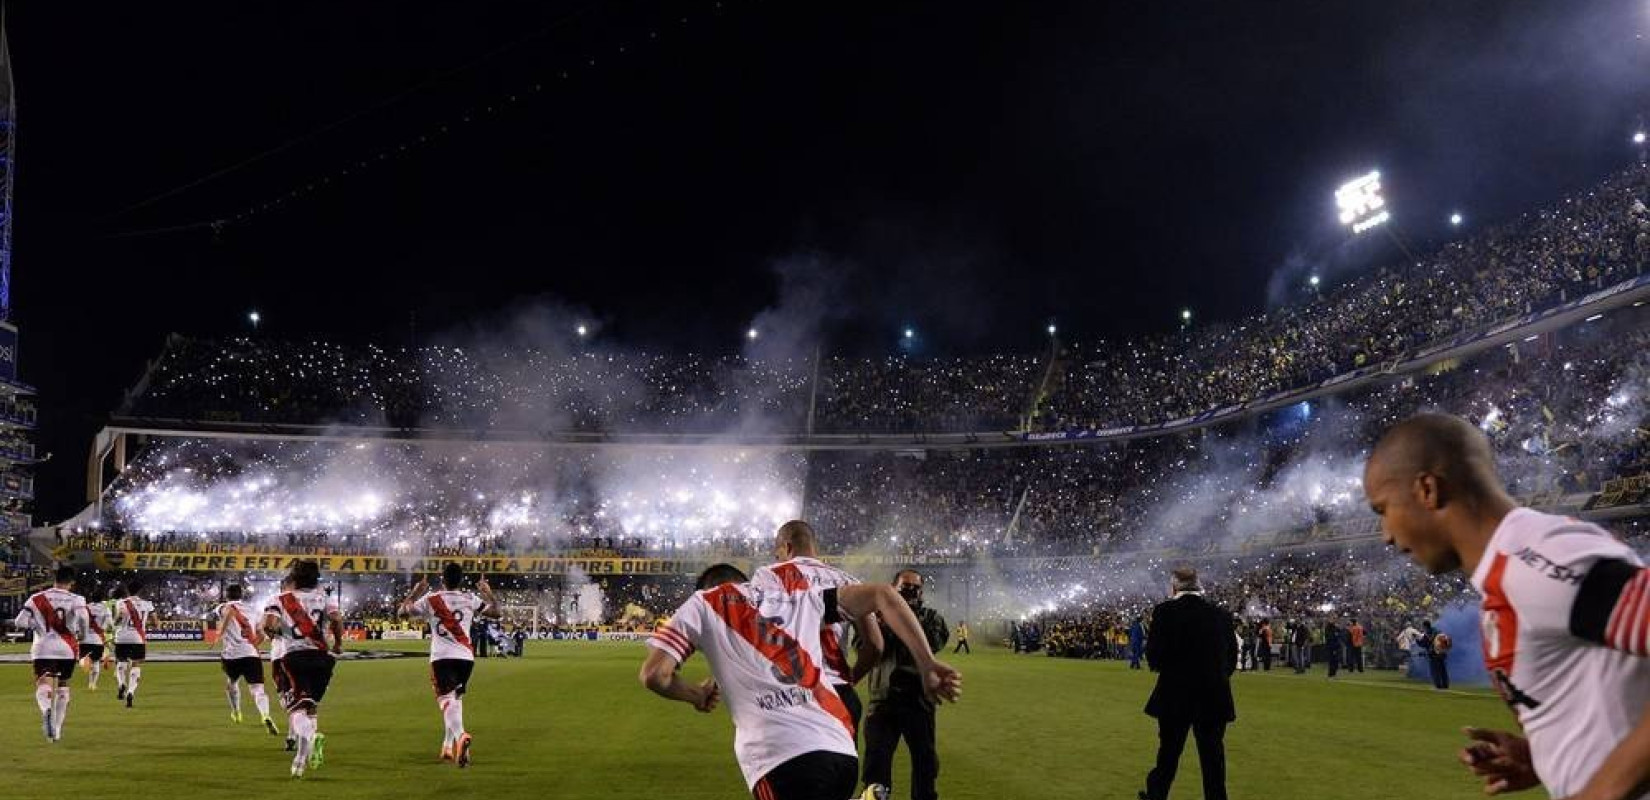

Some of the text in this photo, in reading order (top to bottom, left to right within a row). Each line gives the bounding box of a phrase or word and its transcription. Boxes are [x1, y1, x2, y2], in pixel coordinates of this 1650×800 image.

[136, 555, 238, 569] SIEMPRE
[243, 556, 331, 570] ESTAE
[340, 558, 355, 570] A
[364, 558, 389, 570] TU
[462, 559, 519, 571] BOCA
[562, 631, 588, 641] VISA
[757, 614, 805, 685] 5
